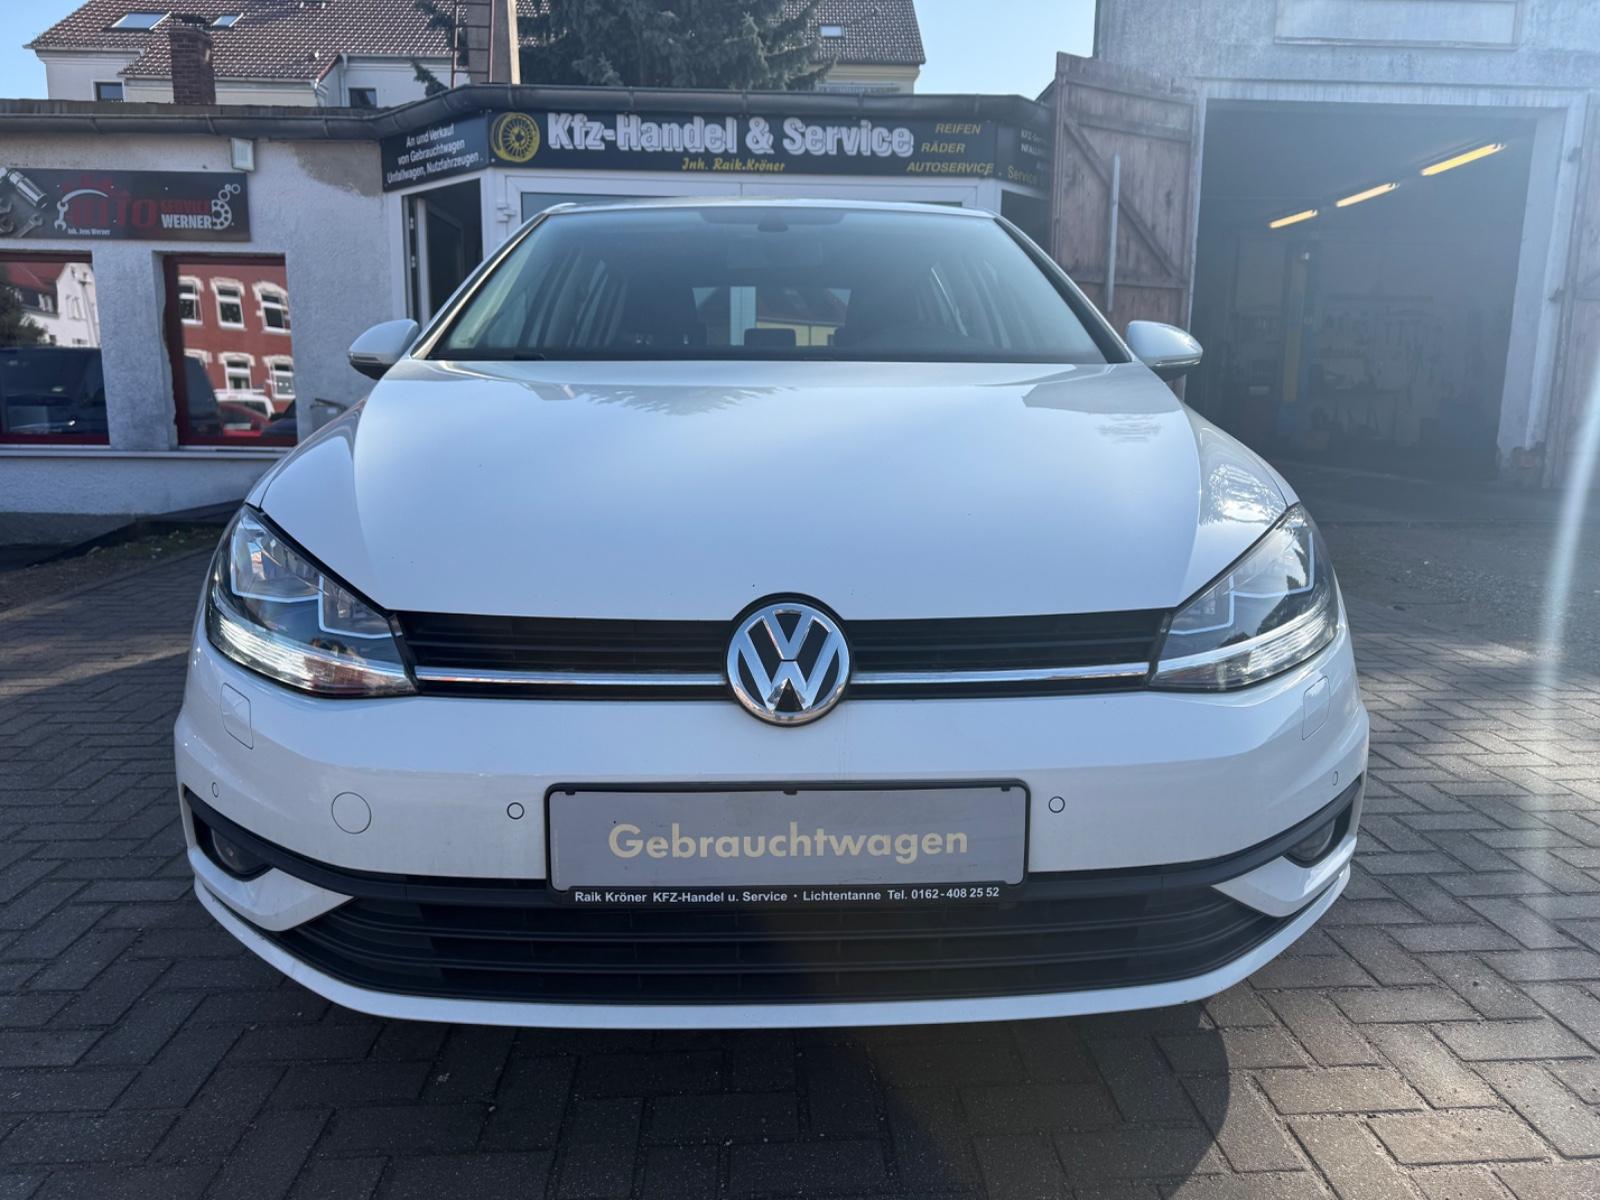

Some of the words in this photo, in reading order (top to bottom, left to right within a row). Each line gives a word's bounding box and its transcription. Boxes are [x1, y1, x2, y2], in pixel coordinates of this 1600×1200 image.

[416, 132, 429, 145] und
[430, 124, 454, 140] Verkauf
[546, 112, 737, 155] Kfz-Handel
[745, 116, 775, 155] &
[782, 116, 915, 158] Service
[935, 122, 982, 135] REIFEN
[398, 155, 410, 165] von
[410, 140, 465, 162] Gebrauchtwagen
[920, 140, 966, 154] RÄDER
[427, 152, 479, 173] Nutzfahrzeugen
[682, 157, 709, 171] Inh.
[906, 161, 995, 176] AUTOSERVICE
[161, 213, 212, 229] WERNER
[734, 605, 843, 717] VW
[608, 821, 968, 864] Gebrauchtwagen
[575, 891, 602, 903] Raik
[605, 891, 648, 903] Kröner
[652, 891, 724, 903] KFZ-Handel
[727, 893, 739, 902] u.
[742, 890, 788, 902] Service
[803, 889, 882, 902] Lichtentanne
[888, 889, 908, 900] Tel.
